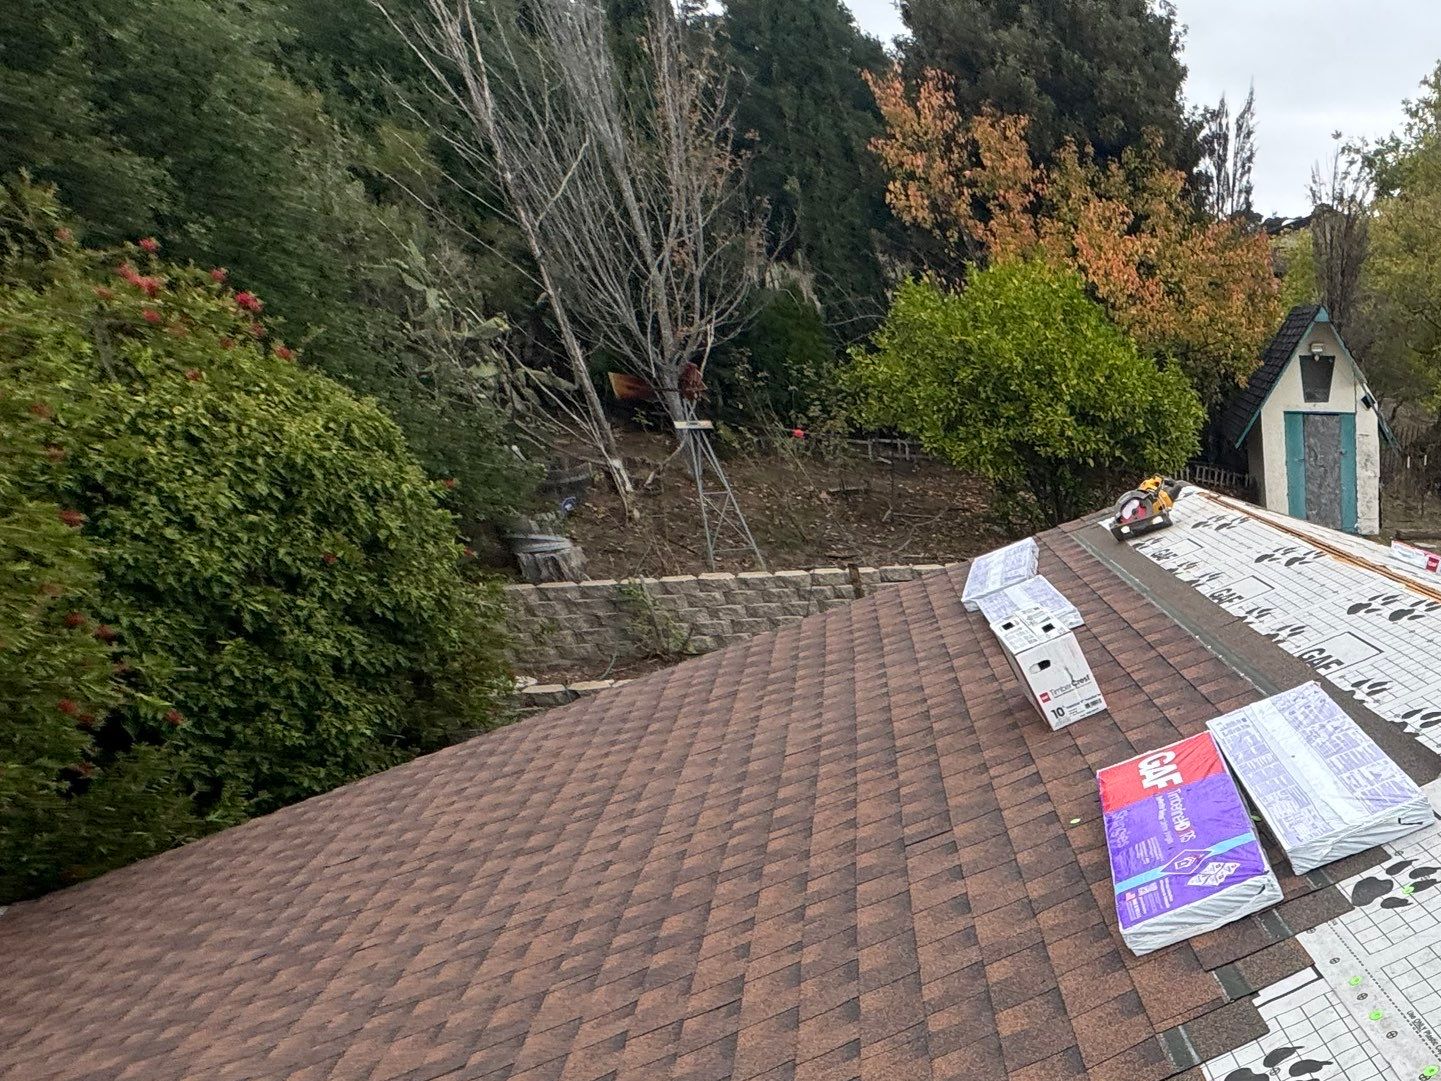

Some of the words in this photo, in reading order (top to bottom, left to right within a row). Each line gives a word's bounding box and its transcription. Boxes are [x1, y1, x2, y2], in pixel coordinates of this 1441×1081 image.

[1209, 588, 1245, 605] GAF
[1300, 648, 1344, 671] GAF
[1138, 751, 1184, 790] GAF
[1406, 1010, 1417, 1020] Use
[1411, 1018, 1427, 1034] ONLY
[1424, 1029, 1439, 1050] Plastic
